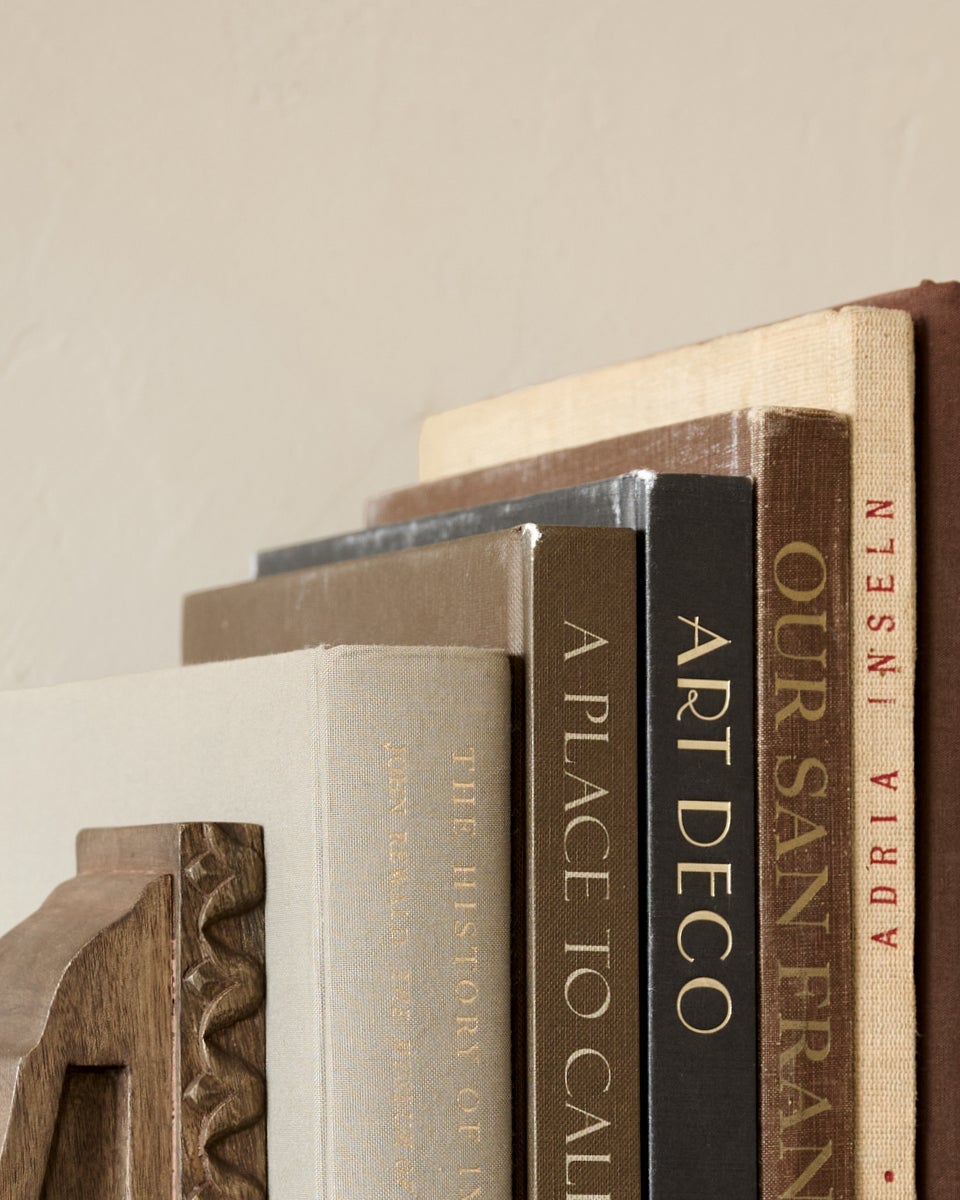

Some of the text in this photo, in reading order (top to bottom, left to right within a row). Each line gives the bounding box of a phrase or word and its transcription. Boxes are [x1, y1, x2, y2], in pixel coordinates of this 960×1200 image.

[564, 620, 609, 661] A
[773, 540, 828, 731] OUR
[866, 499, 897, 704] INSELN
[383, 740, 407, 815] JOHN
[451, 744, 477, 837] THE
[564, 693, 610, 902] PLACE
[676, 614, 733, 1034] ART DECO
[774, 753, 830, 934] SAN
[869, 770, 900, 948] ADRIA
[388, 831, 409, 946] REWALD
[451, 863, 479, 1064] HISTORY
[564, 928, 611, 1019] TO
[454, 1087, 481, 1144] OF
